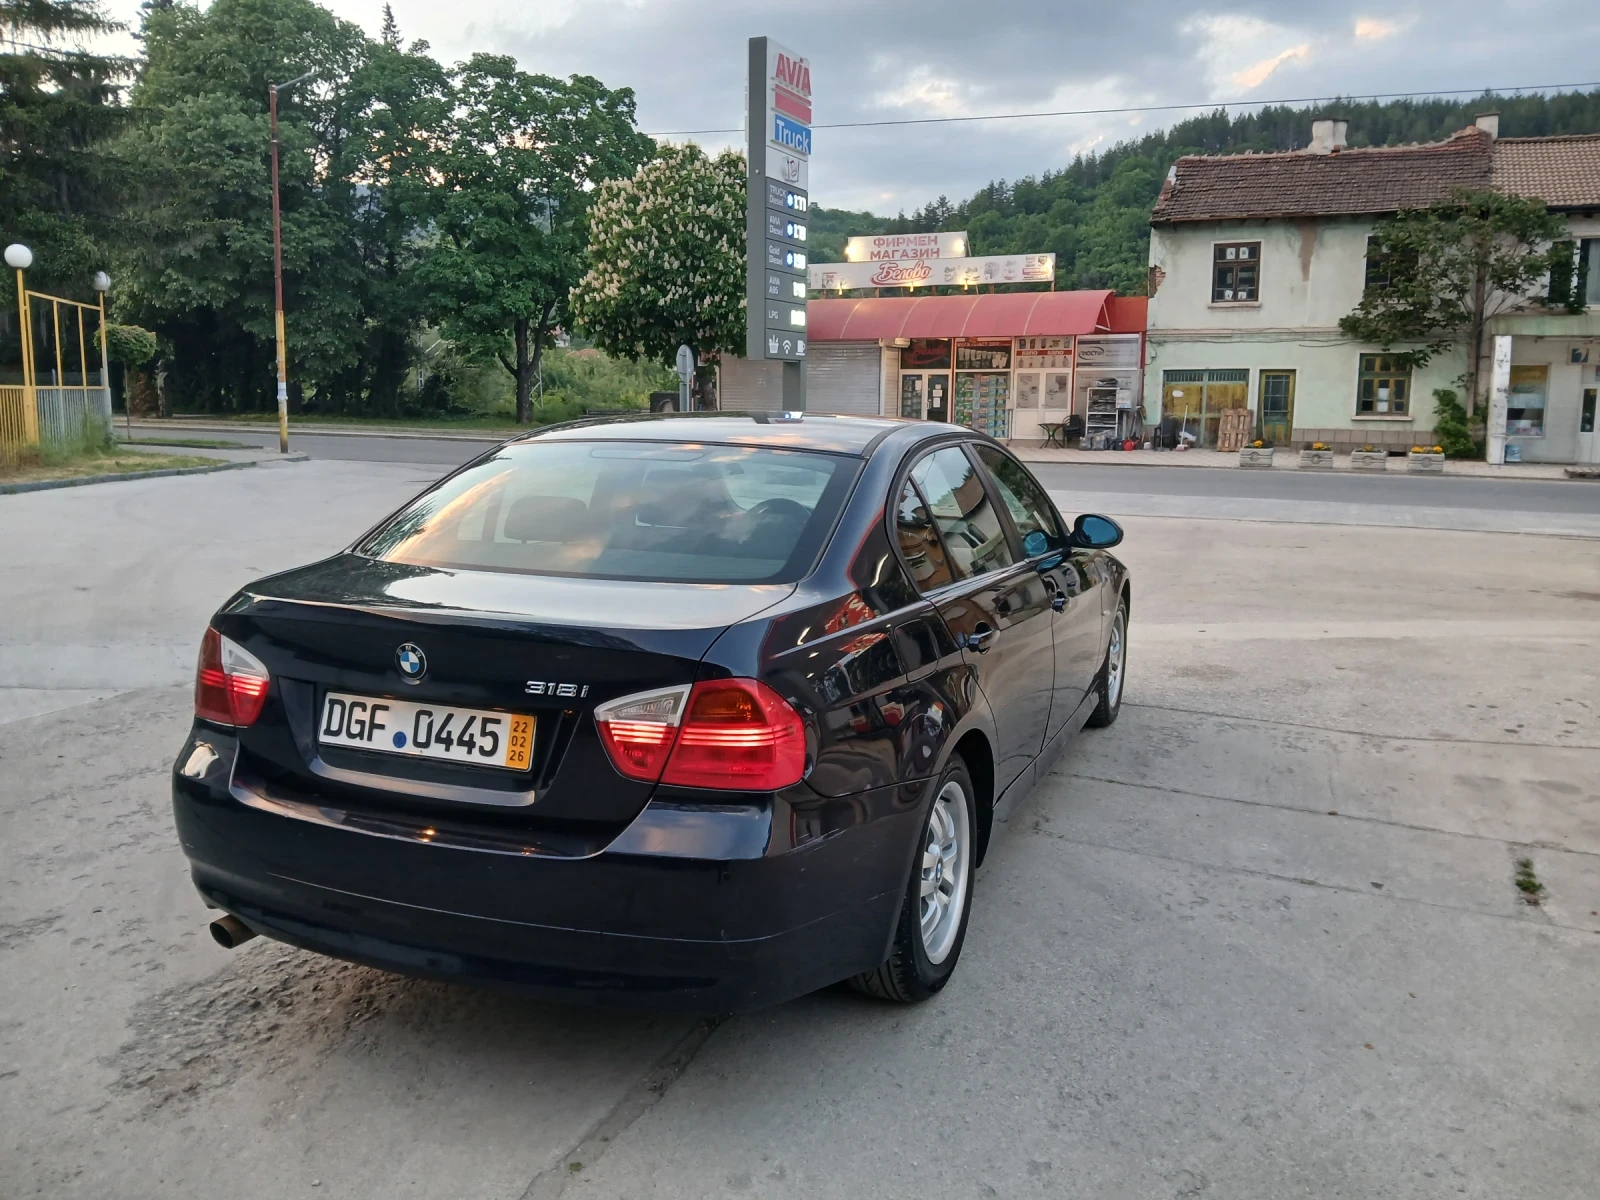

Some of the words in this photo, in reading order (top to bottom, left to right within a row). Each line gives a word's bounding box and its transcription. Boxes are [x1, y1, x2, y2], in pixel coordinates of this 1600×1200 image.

[776, 119, 810, 154] Truck
[769, 184, 787, 198] TRUCK
[769, 194, 784, 206] Diesel
[769, 224, 784, 236] Diesel
[873, 235, 938, 249] ФИРМЕН
[768, 244, 780, 256] Gold
[869, 247, 940, 261] МАГАЗИН
[768, 254, 783, 266] Diesel
[876, 260, 932, 281] Белово
[768, 309, 779, 320] LPG
[525, 680, 590, 698] 318i
[323, 697, 390, 743] DGF
[412, 708, 502, 758] 0445
[512, 720, 529, 734] 22
[511, 735, 527, 748] 02
[509, 749, 525, 762] 26
